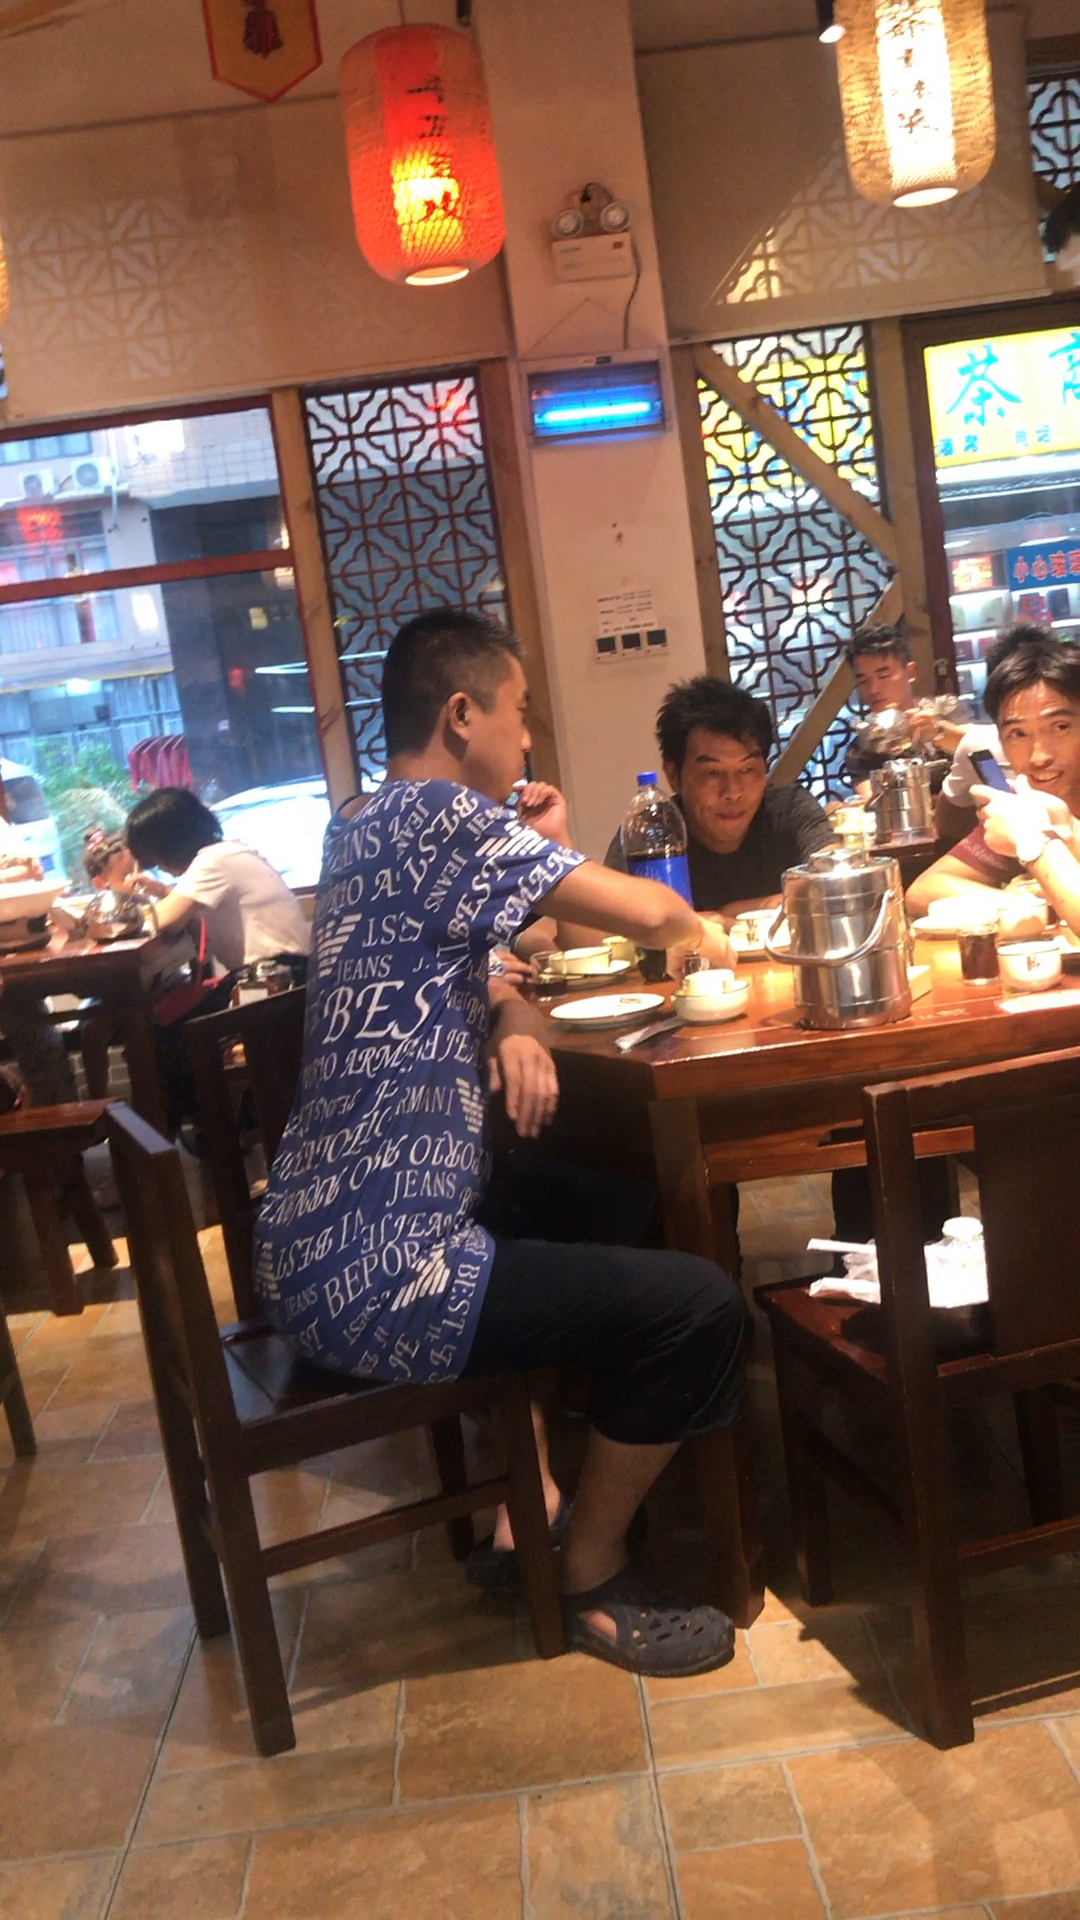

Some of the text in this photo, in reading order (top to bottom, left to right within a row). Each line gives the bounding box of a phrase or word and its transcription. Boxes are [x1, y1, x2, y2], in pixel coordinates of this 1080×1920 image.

[335, 953, 394, 986] JEANS
[386, 1168, 458, 1208] JEANS
[443, 1262, 482, 1337] BEST
